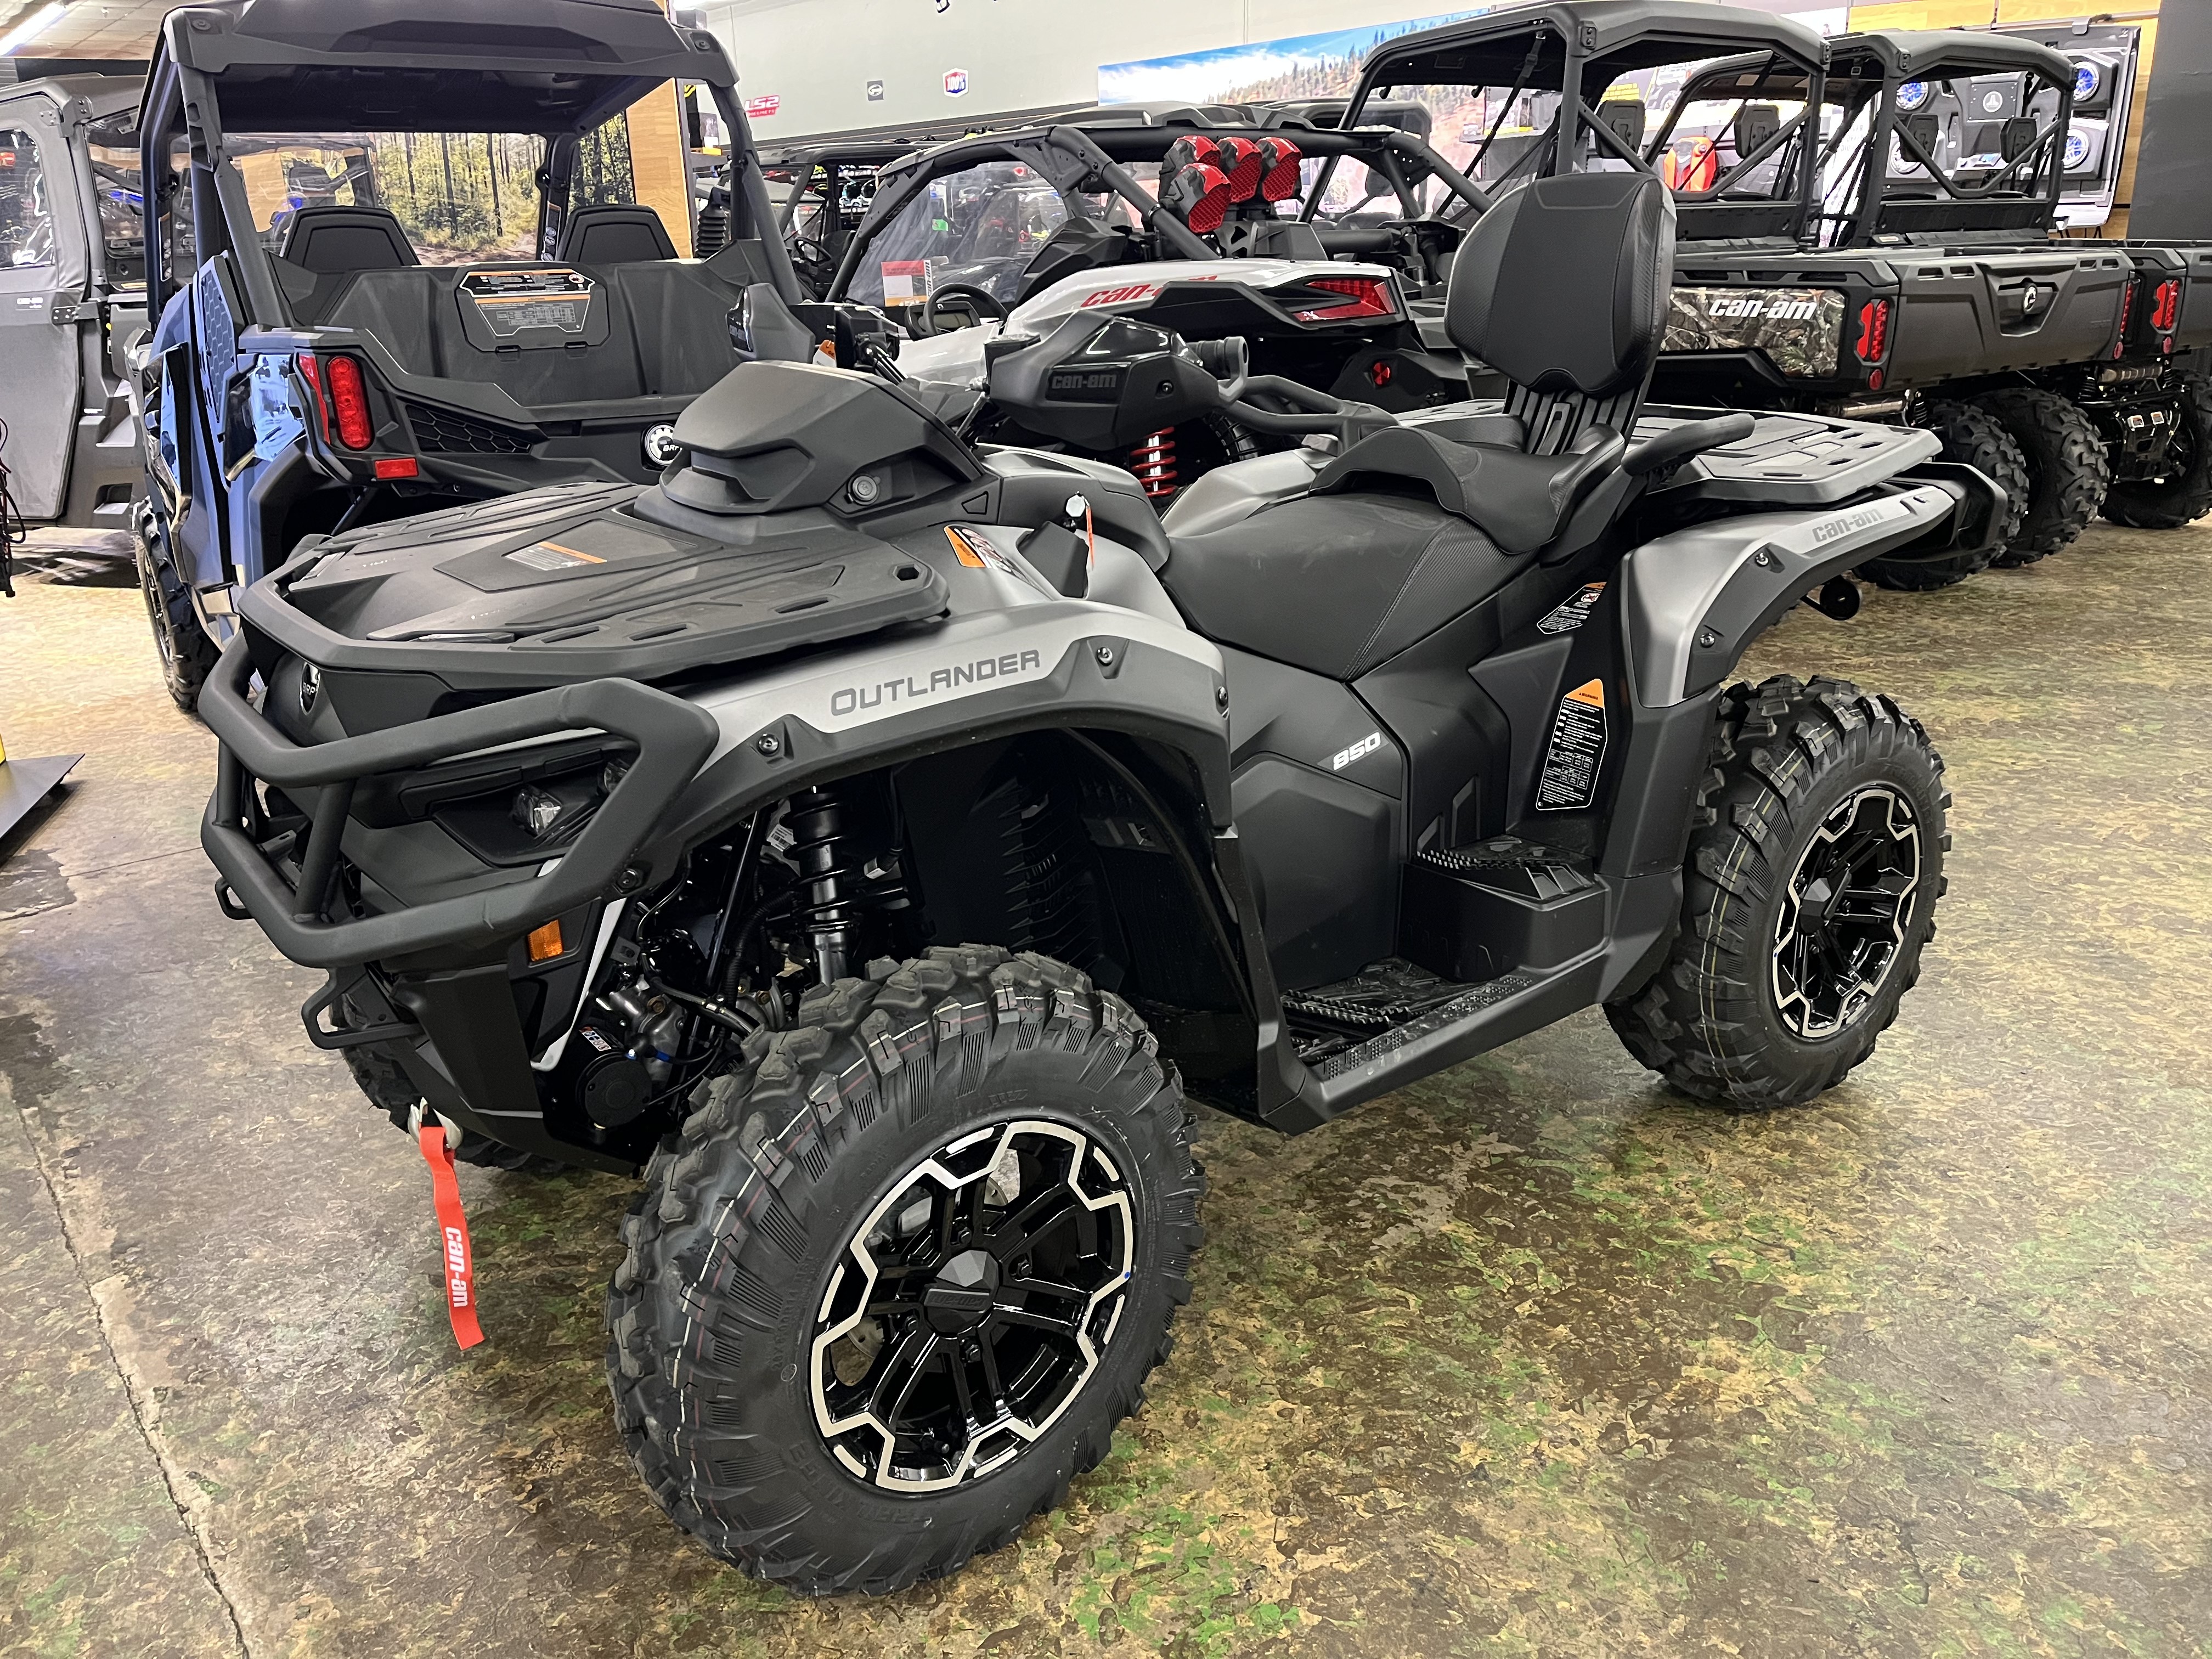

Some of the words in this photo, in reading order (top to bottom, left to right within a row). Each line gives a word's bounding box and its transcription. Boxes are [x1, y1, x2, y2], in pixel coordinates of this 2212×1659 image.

[946, 72, 967, 92] 100%
[744, 95, 780, 112] LS2
[1708, 299, 1818, 320] can-am
[1051, 374, 1117, 389] can-am
[1812, 509, 1884, 542] can-am
[302, 682, 316, 696] BRP
[831, 649, 1040, 716] OUTLANDER
[1333, 732, 1381, 770] 850
[445, 1226, 468, 1307] can-am
